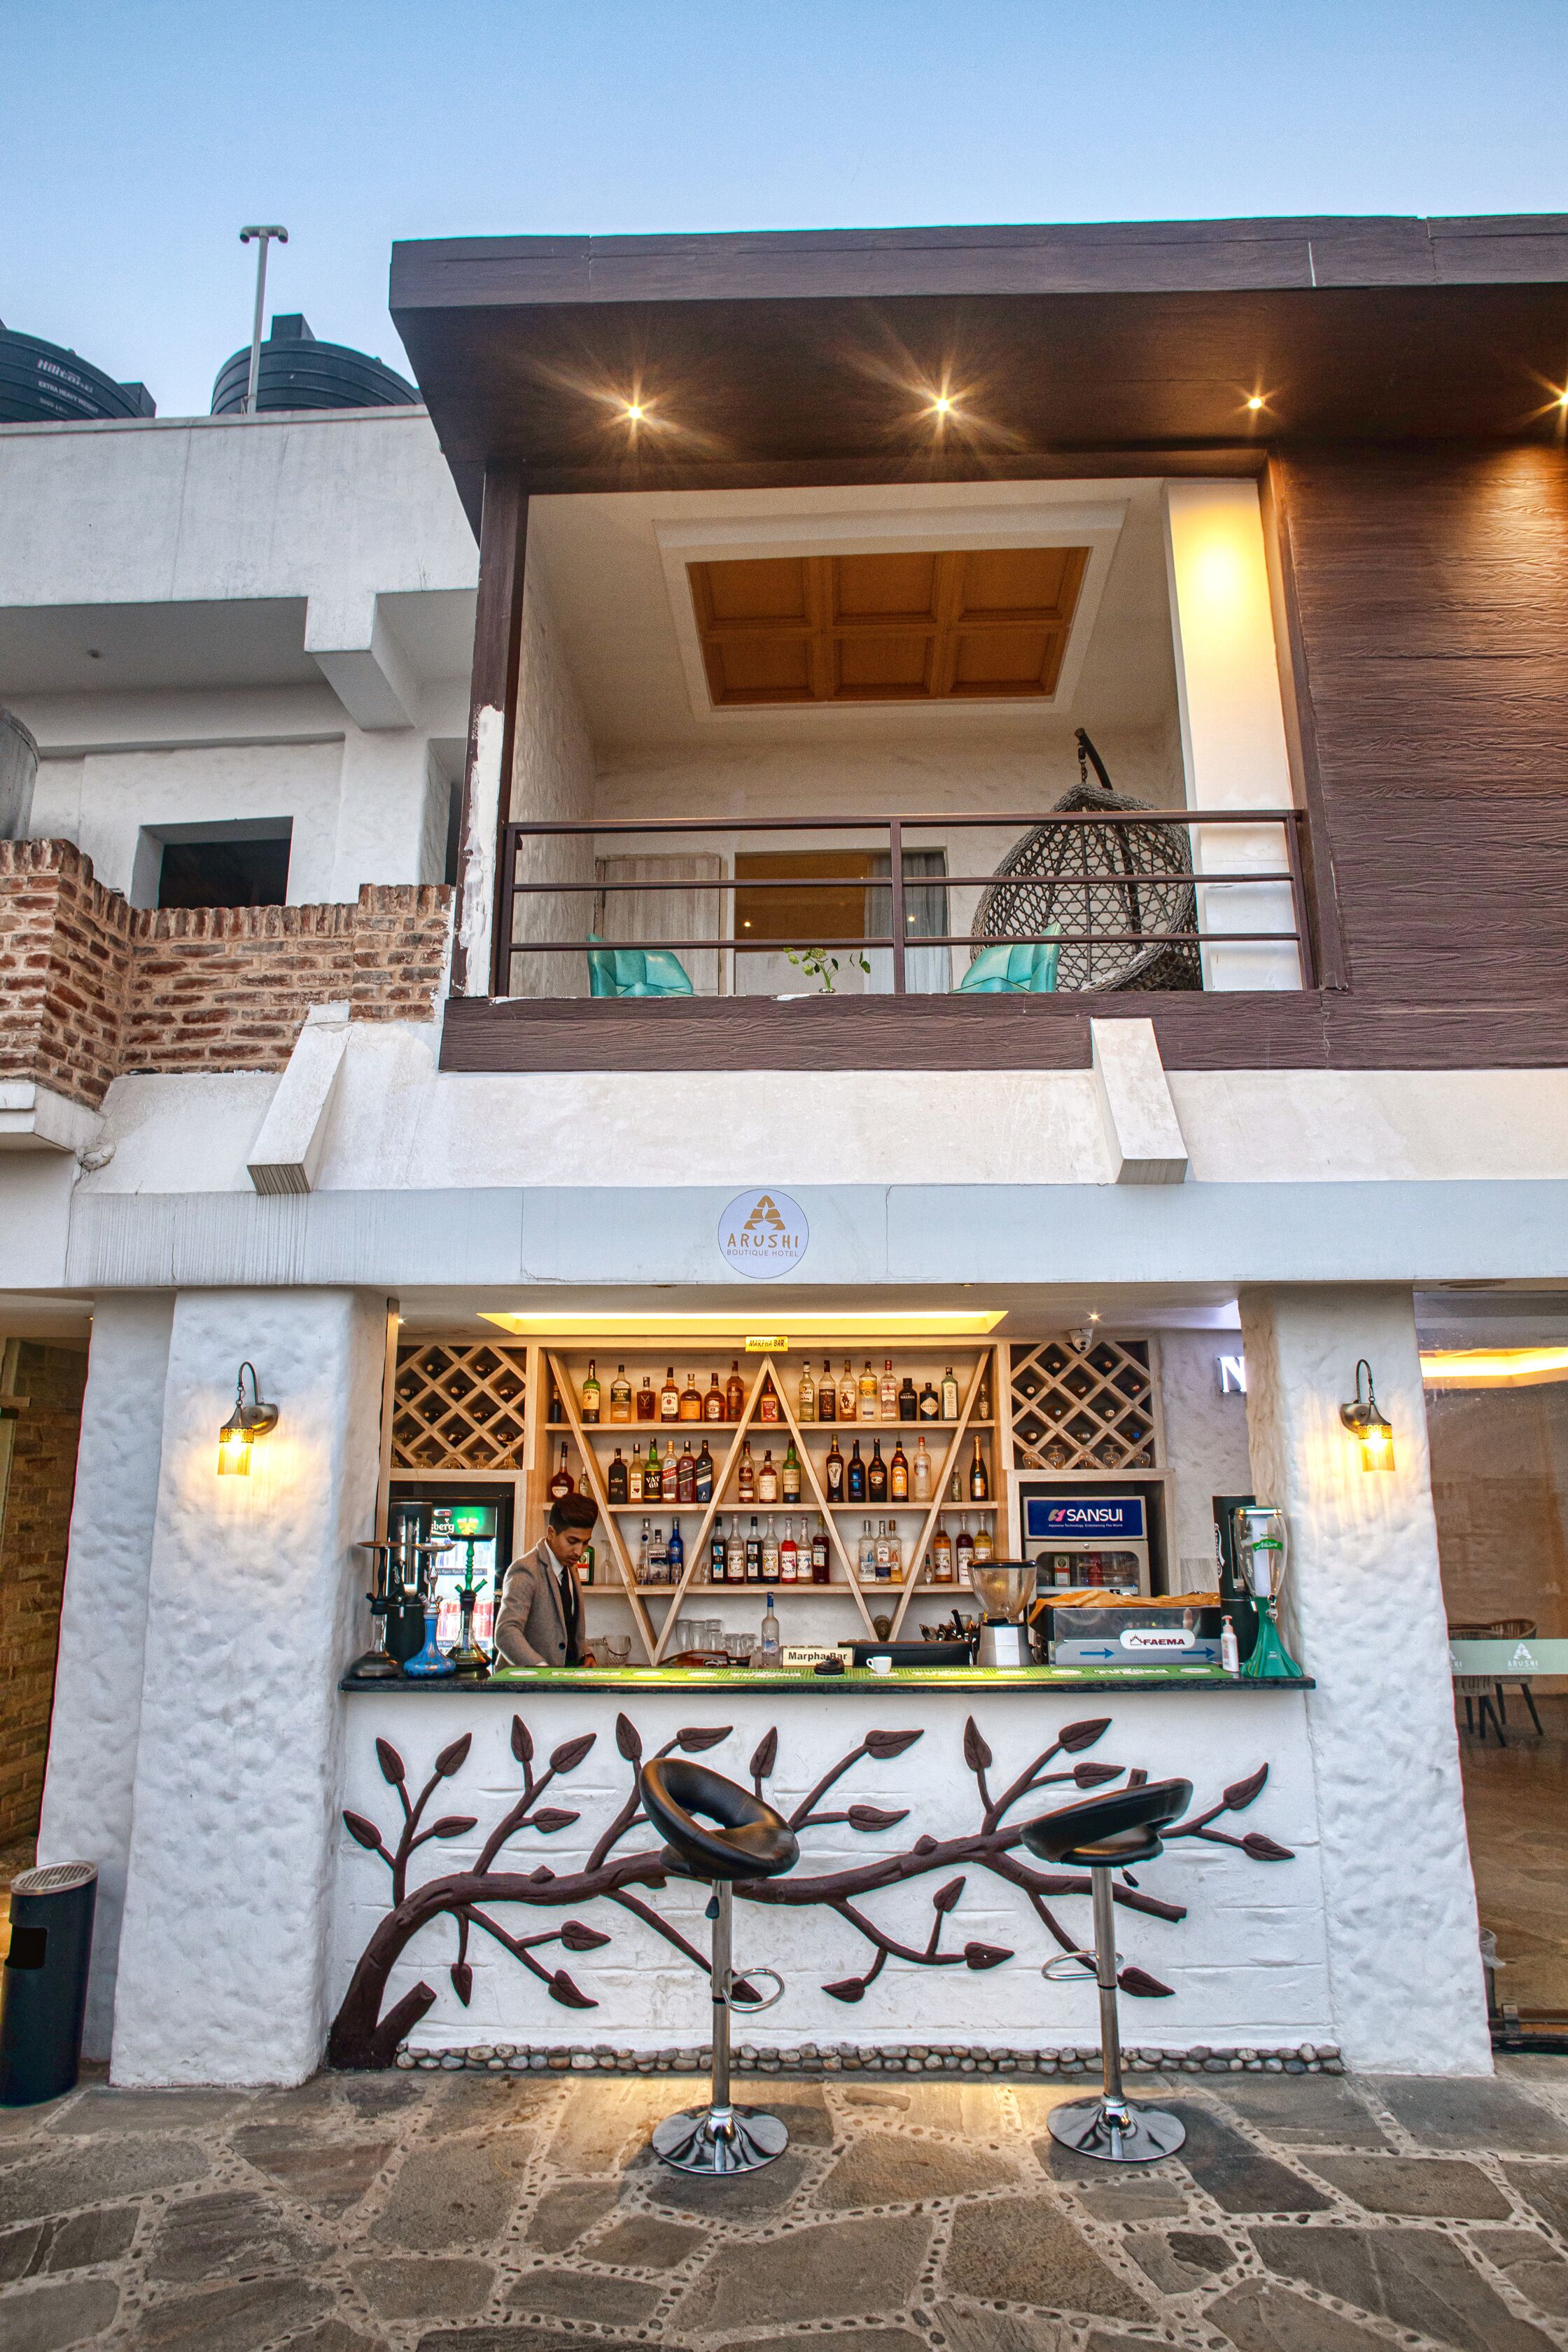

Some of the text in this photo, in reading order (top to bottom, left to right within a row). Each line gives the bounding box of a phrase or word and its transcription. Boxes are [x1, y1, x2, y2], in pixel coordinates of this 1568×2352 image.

[38, 380, 58, 393] EXTRA
[727, 1233, 799, 1249] ARUSHI
[1067, 1508, 1123, 1522] SANSUI
[788, 1652, 826, 1662] Marpha
